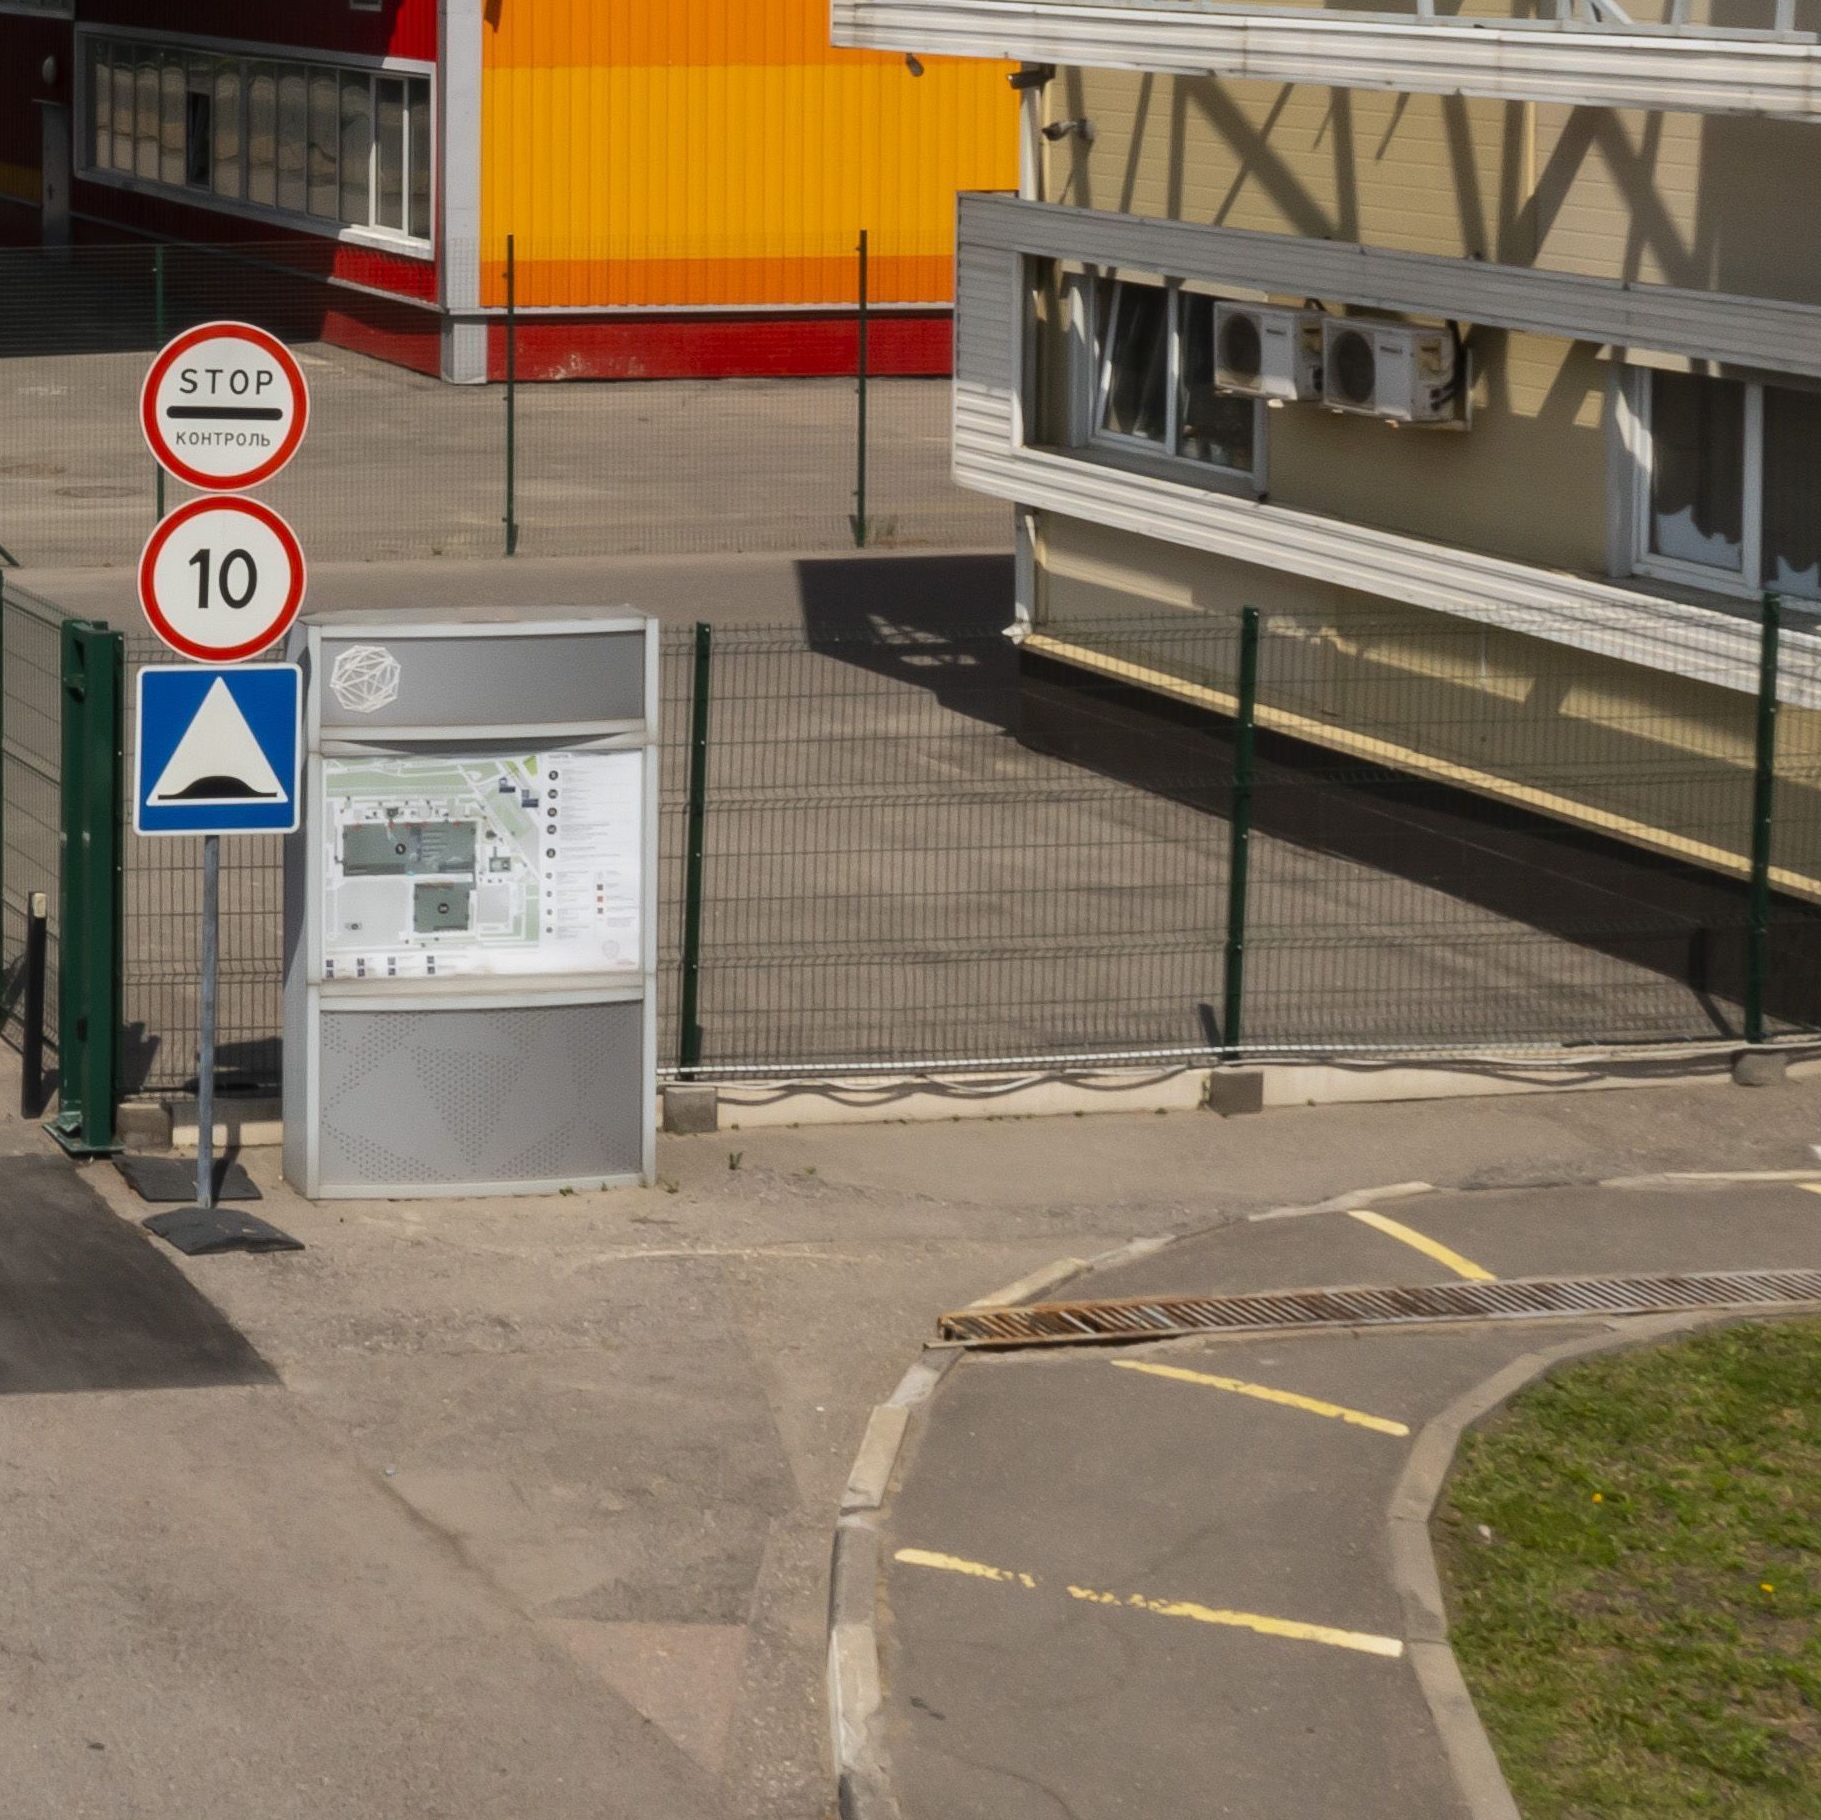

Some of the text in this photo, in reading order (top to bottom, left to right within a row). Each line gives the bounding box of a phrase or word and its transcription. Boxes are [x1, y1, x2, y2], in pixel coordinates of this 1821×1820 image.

[179, 369, 273, 395] STOP
[176, 432, 271, 447] КОНТРОЛЬ
[189, 548, 257, 609] 10
